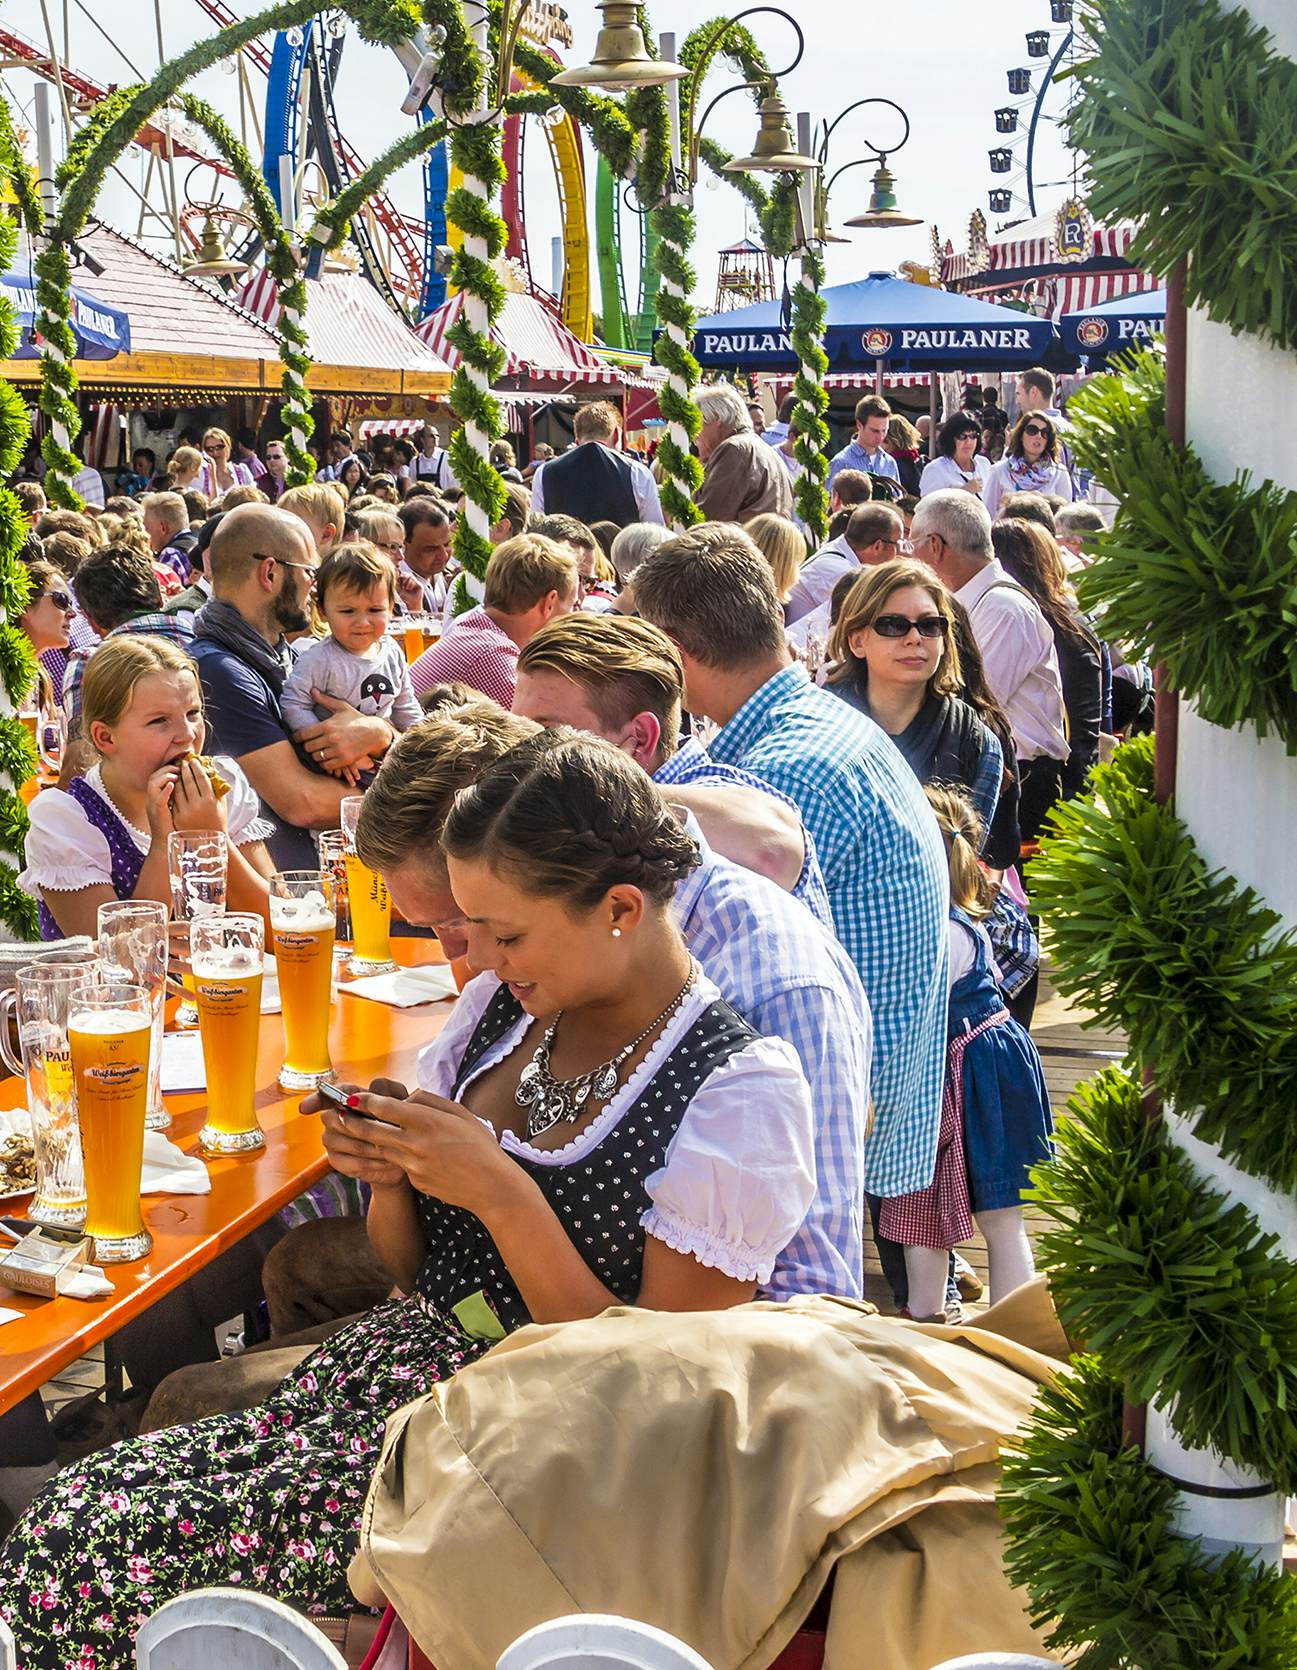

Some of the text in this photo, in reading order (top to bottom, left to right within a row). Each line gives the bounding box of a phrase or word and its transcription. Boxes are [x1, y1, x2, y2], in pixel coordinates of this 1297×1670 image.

[901, 328, 1031, 349] PAULANER
[1118, 319, 1166, 339] PAU
[703, 333, 827, 354] PAULAN
[46, 1051, 70, 1062] PAU
